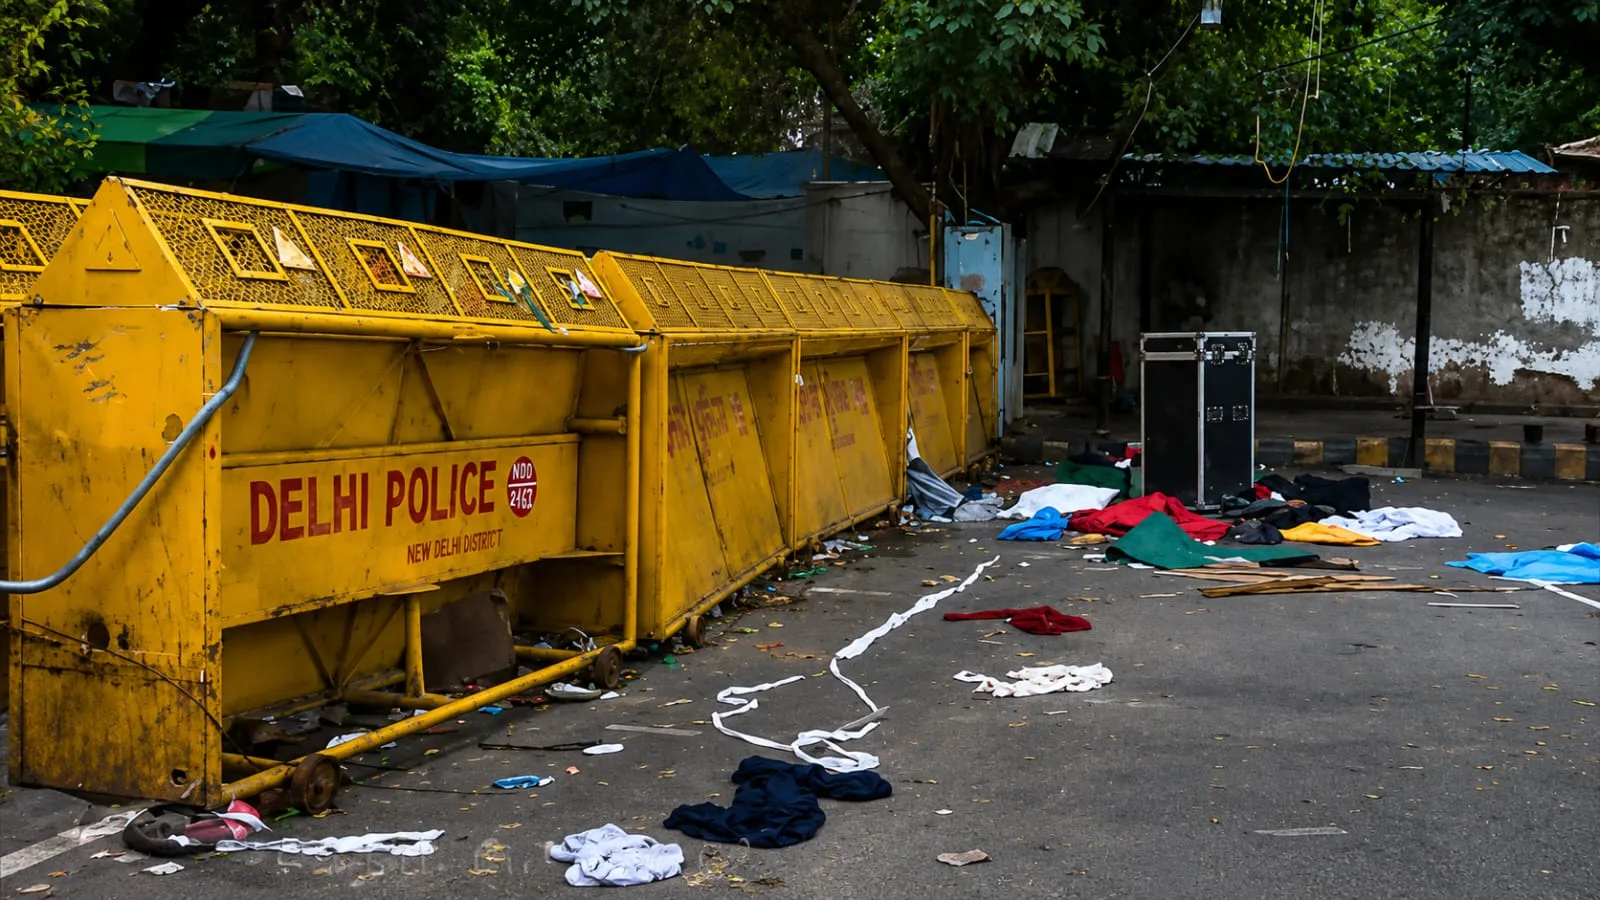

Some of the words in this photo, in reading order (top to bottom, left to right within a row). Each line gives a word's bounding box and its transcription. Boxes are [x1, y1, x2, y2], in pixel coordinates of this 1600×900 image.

[250, 472, 369, 546] DELHI
[385, 460, 497, 527] POLICE
[407, 541, 432, 565] NEW
[434, 536, 462, 558] DELHI
[463, 529, 503, 553] DISTRICT
